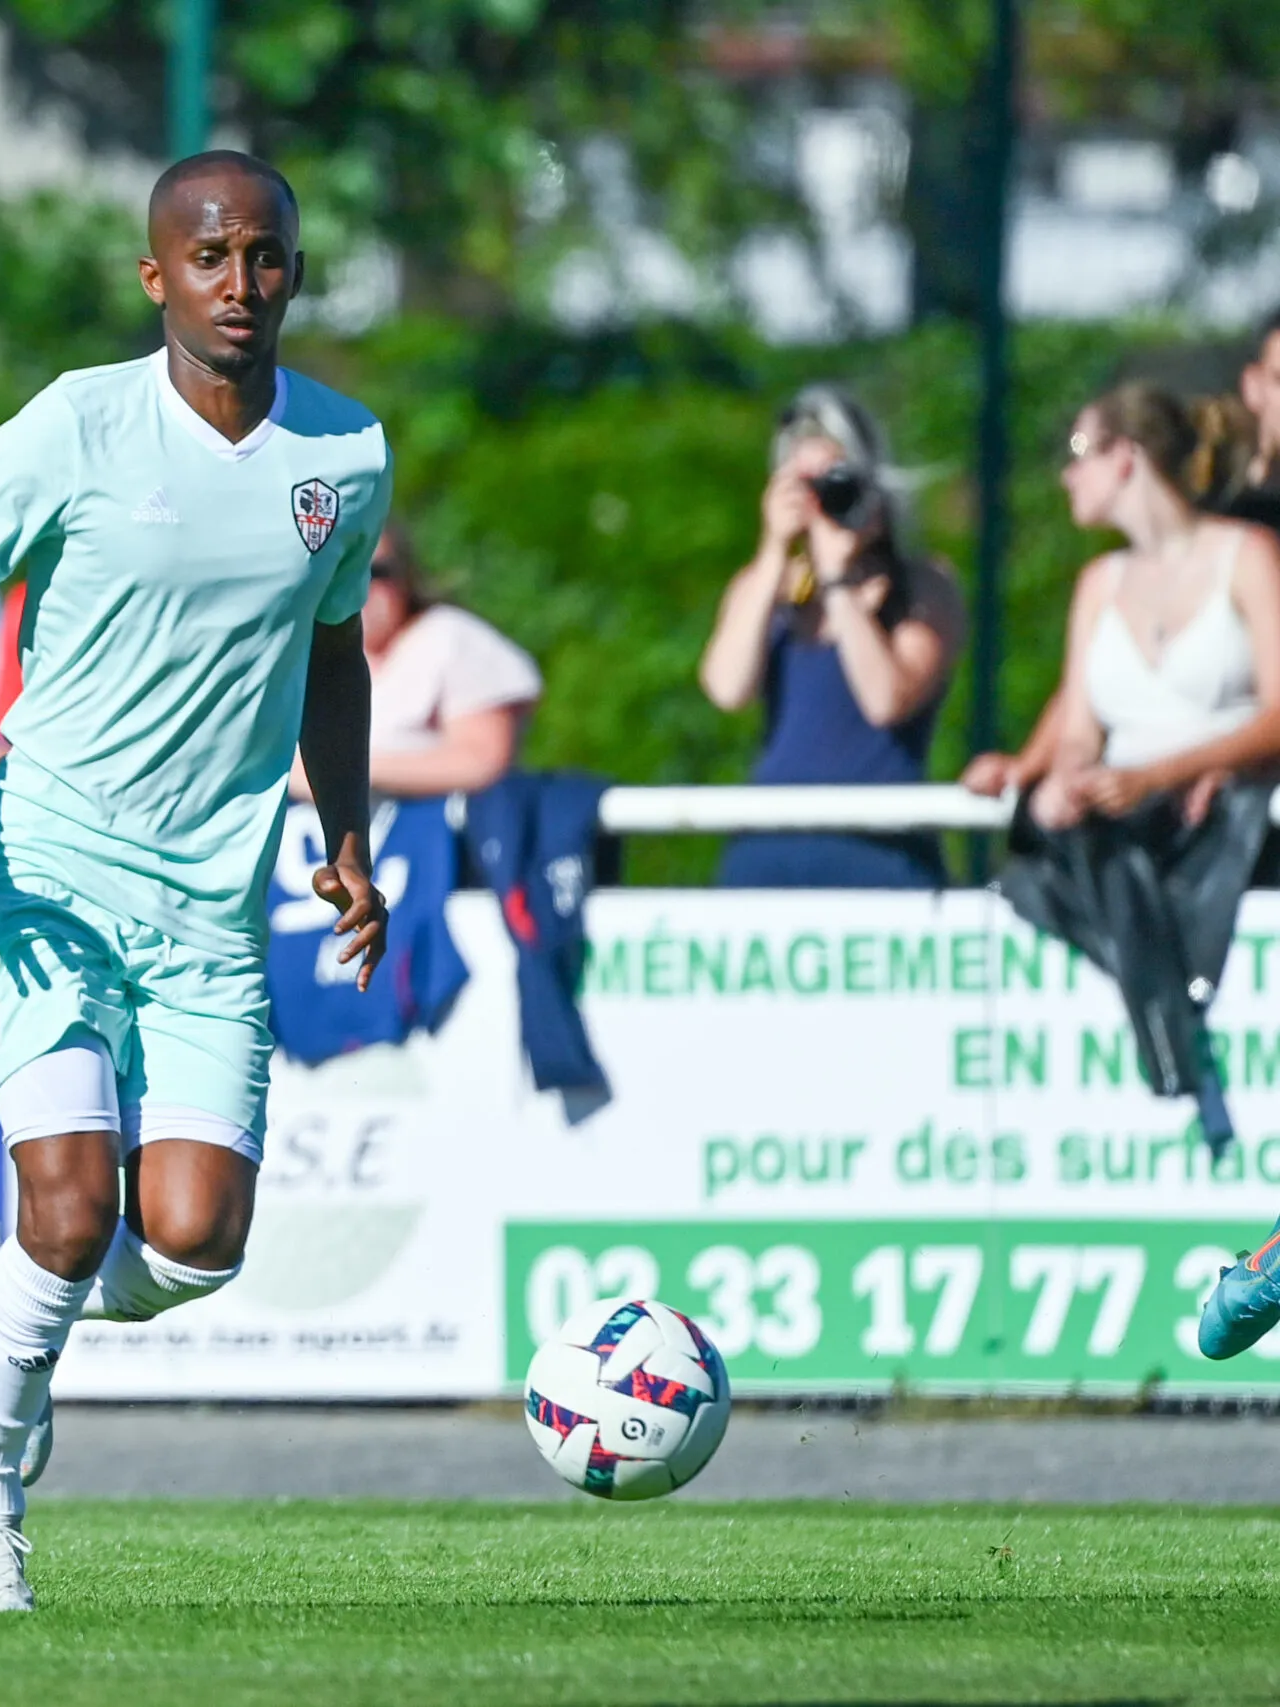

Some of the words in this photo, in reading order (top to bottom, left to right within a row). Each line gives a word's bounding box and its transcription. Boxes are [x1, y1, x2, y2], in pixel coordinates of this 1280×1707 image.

[578, 914, 1092, 994] MÉNAGEMENT
[953, 1026, 1048, 1089] EN
[702, 1132, 868, 1195] pour
[894, 1117, 1029, 1183] des
[686, 1245, 824, 1358] 33
[850, 1245, 984, 1358] 17
[1008, 1245, 1147, 1358] 77
